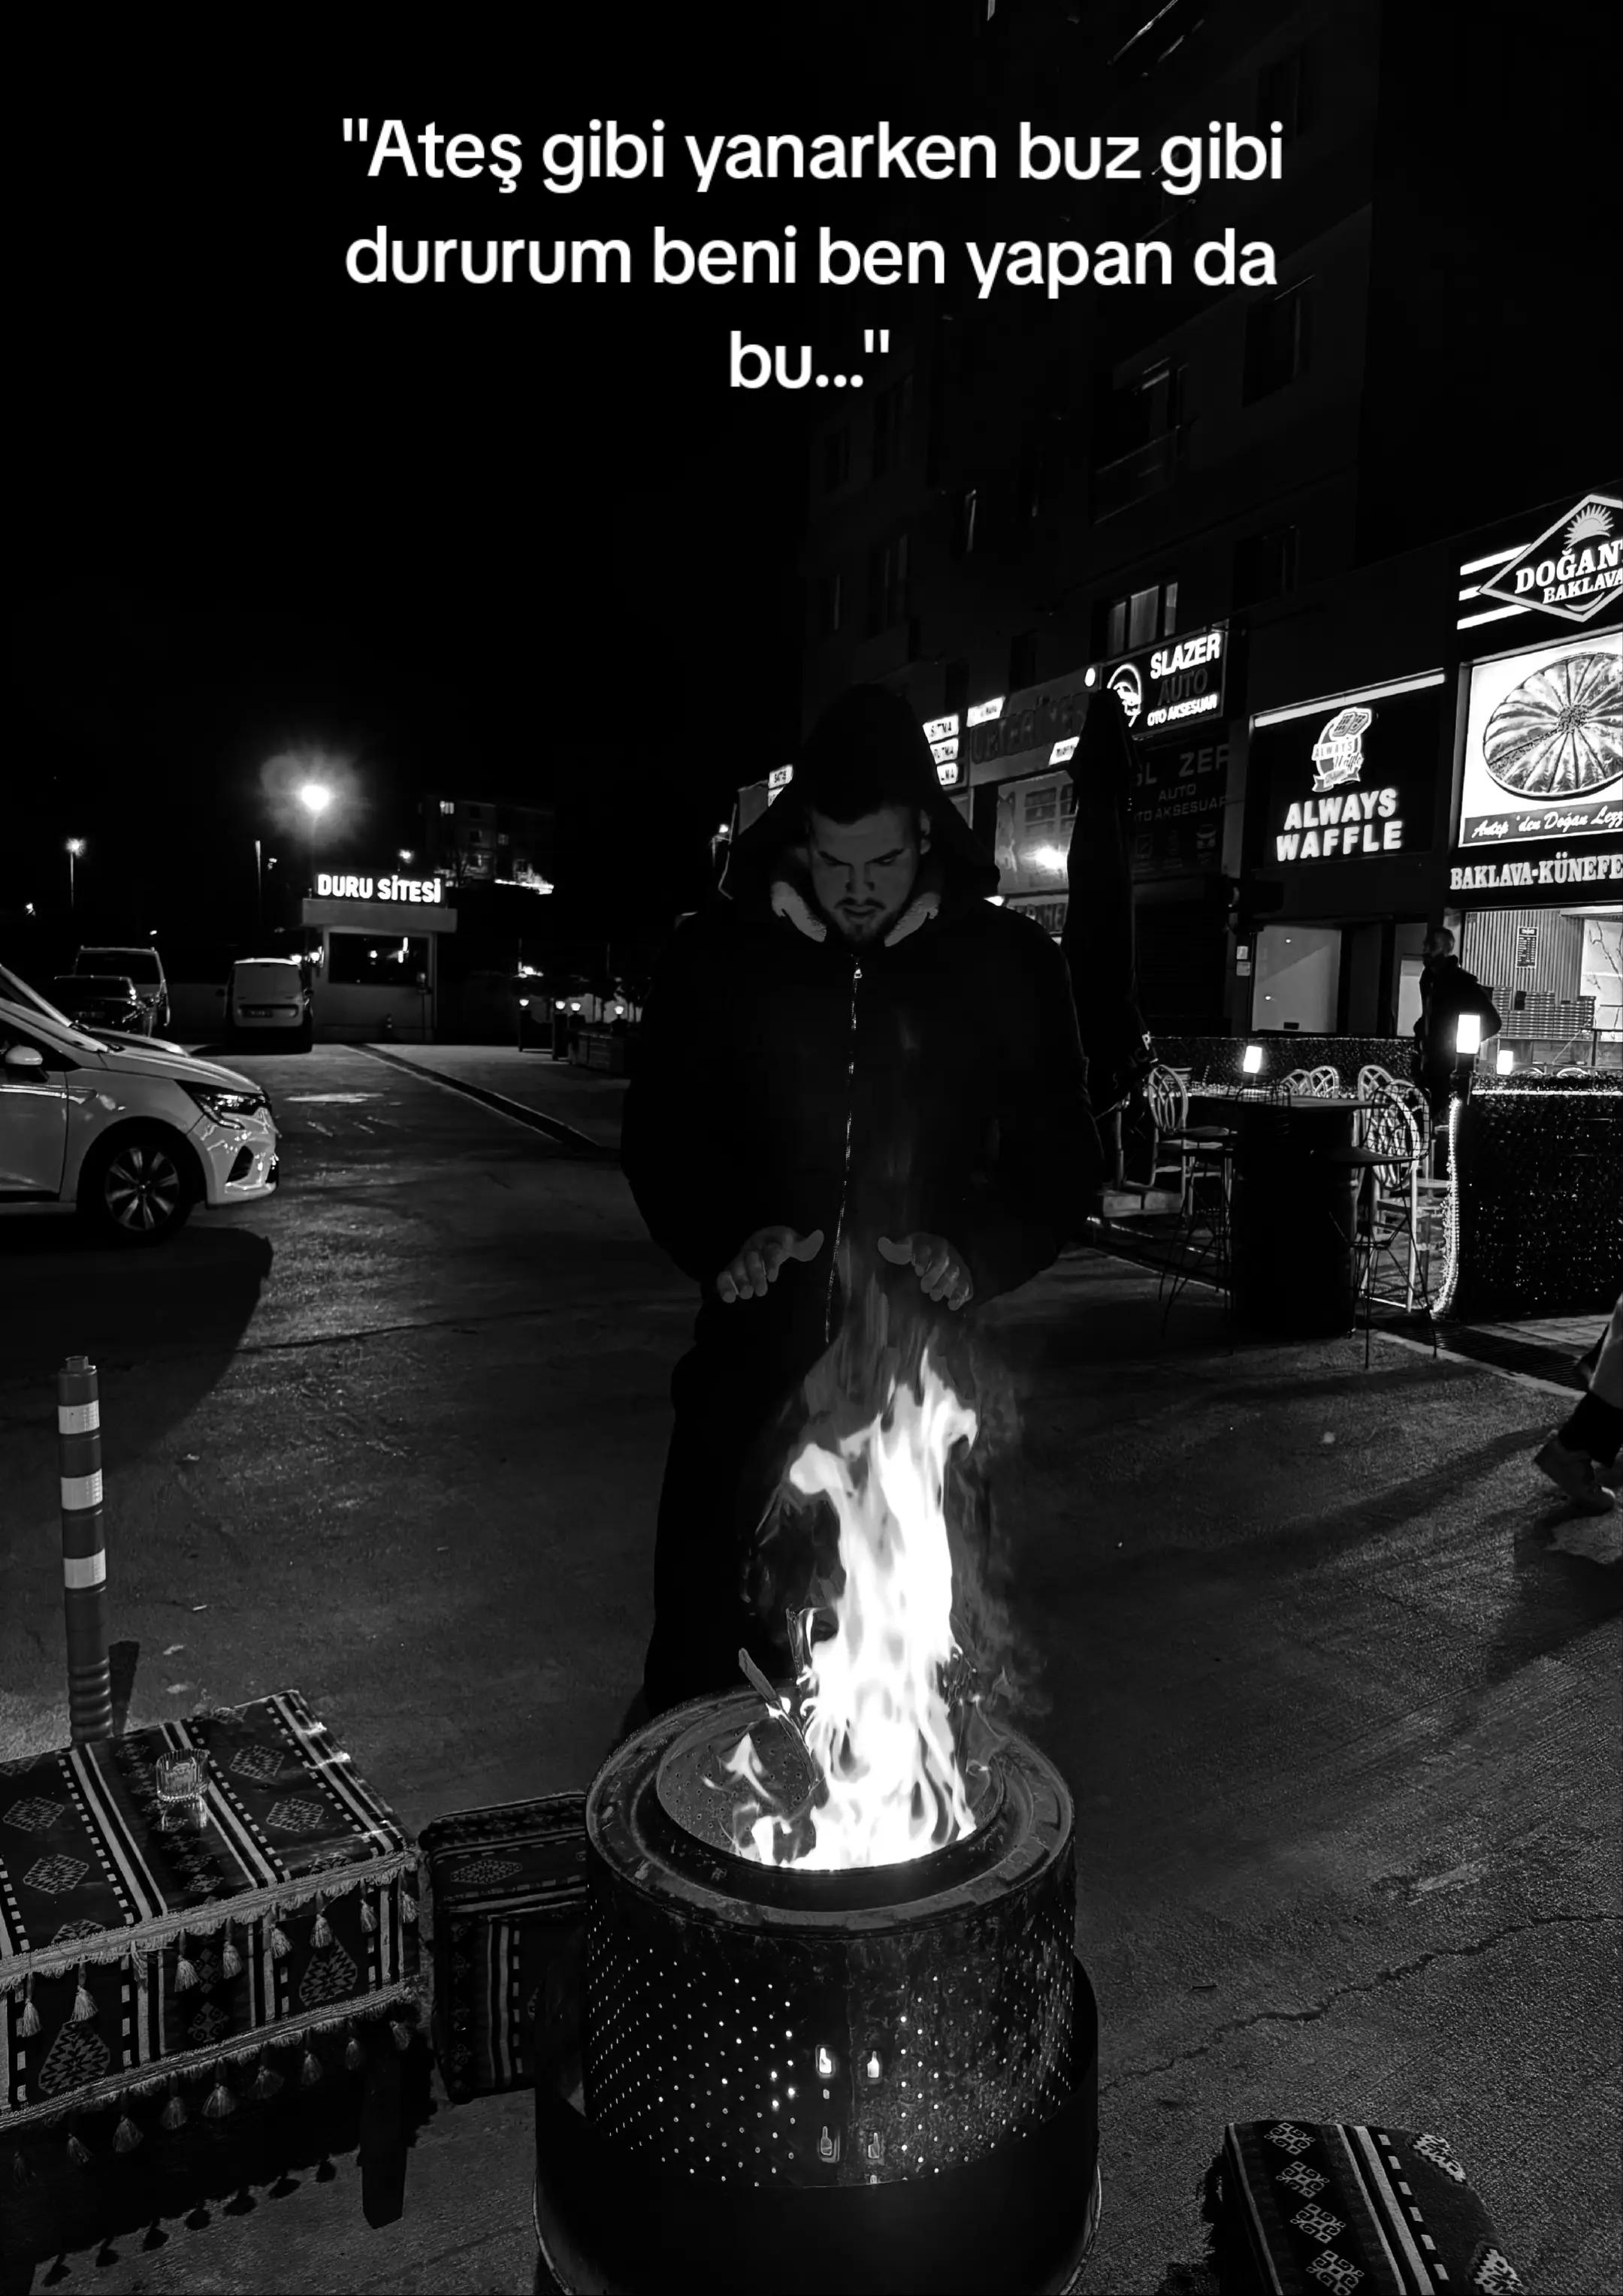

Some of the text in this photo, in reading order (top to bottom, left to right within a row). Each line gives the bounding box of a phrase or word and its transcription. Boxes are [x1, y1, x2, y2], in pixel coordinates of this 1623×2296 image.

[1150, 633, 1221, 679] SLAZER
[1157, 668, 1208, 706] AUTO
[1147, 708, 1167, 727] OTO
[1314, 740, 1352, 758] ALWAYS
[1158, 782, 1196, 802] AUTO
[1283, 788, 1396, 831] ALWAYS
[1277, 820, 1403, 862] WAFFLE
[317, 874, 442, 903] DURU SİTESİ
